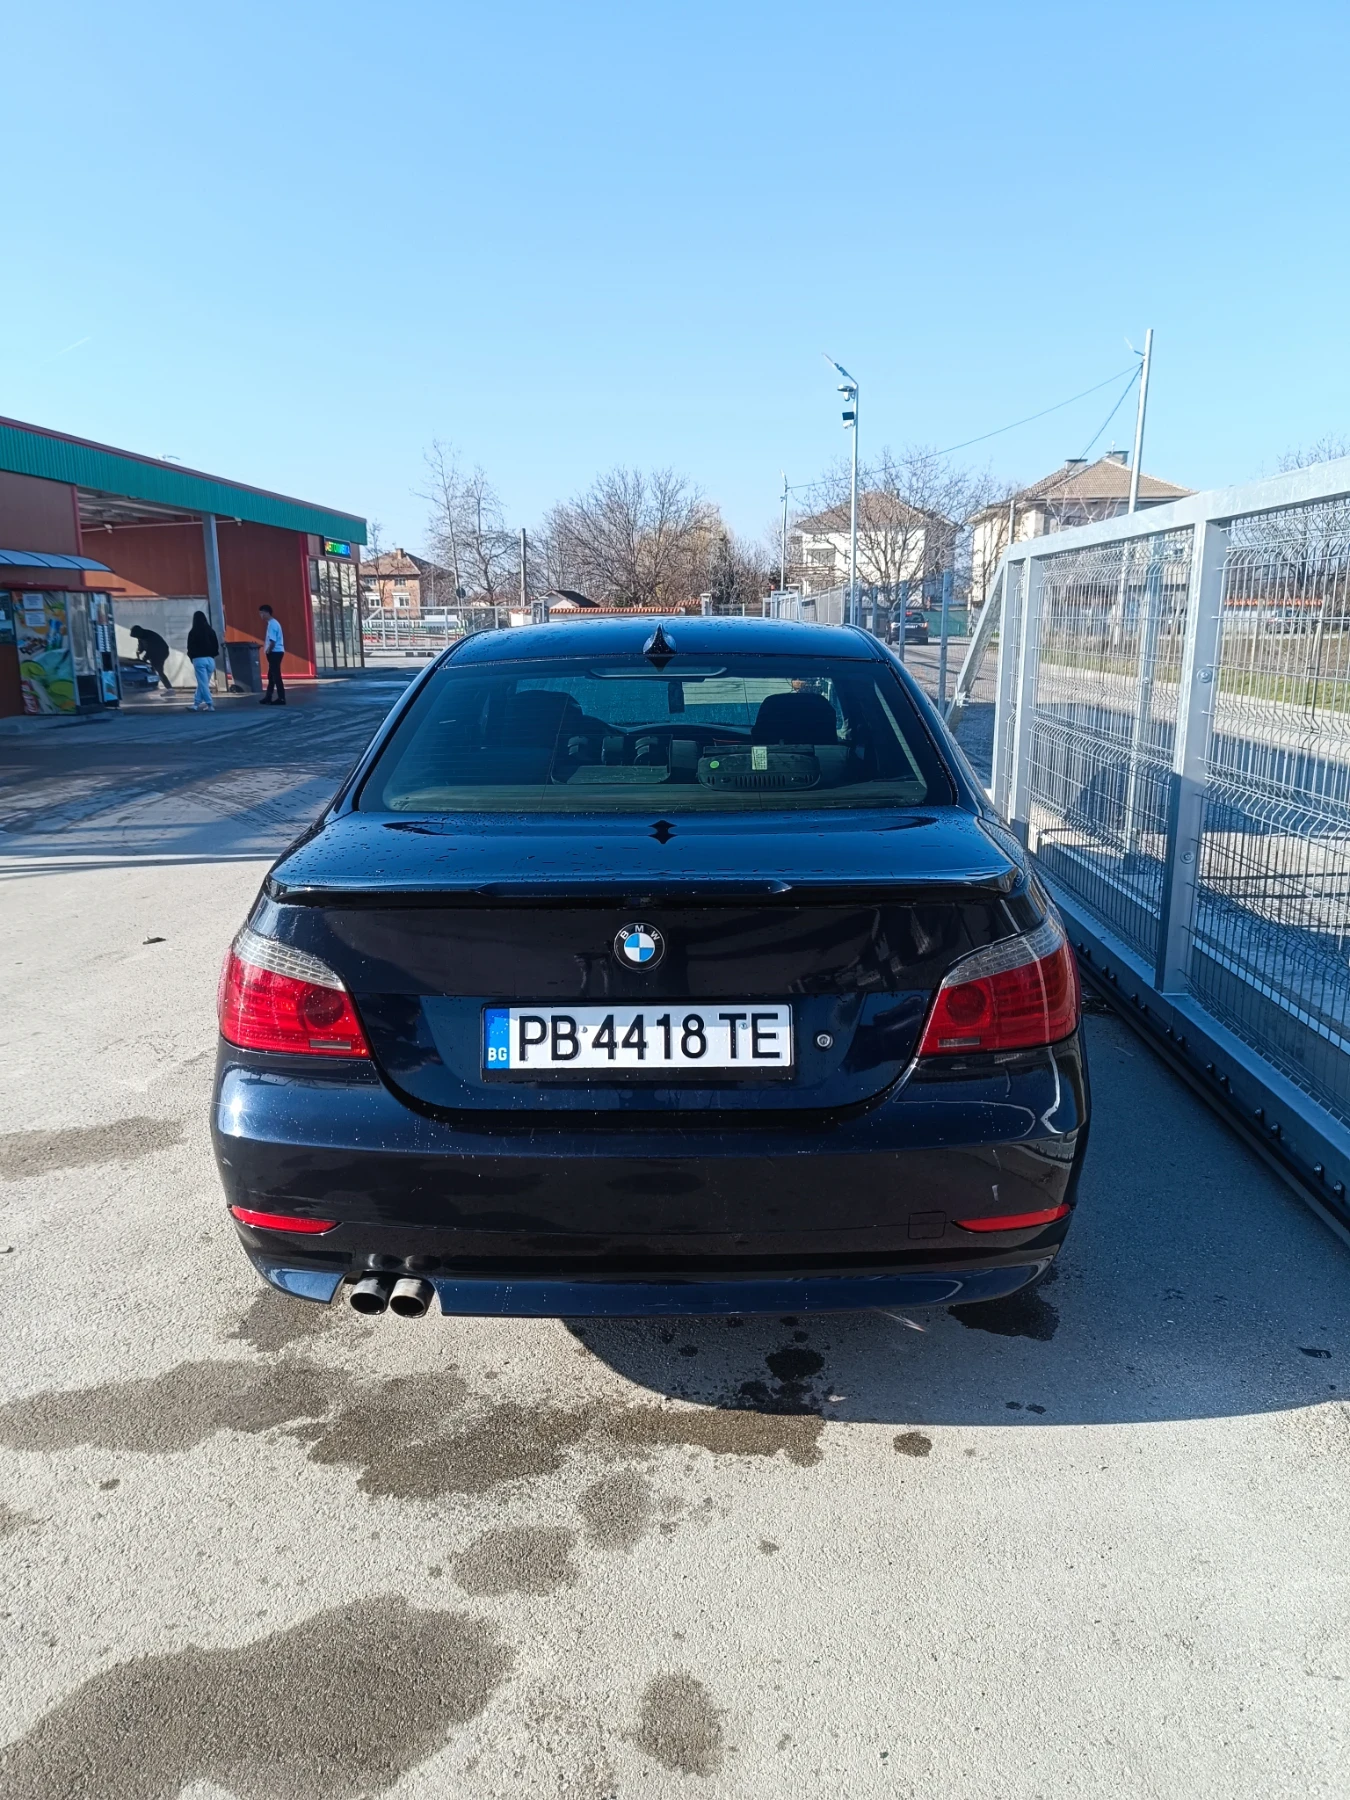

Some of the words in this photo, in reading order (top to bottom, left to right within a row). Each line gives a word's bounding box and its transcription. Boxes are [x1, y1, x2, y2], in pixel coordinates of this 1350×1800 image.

[620, 925, 660, 940] BMW
[518, 1014, 579, 1062] PB
[592, 1013, 707, 1060] 4418
[718, 1012, 781, 1060] TE
[488, 1047, 507, 1061] BG
